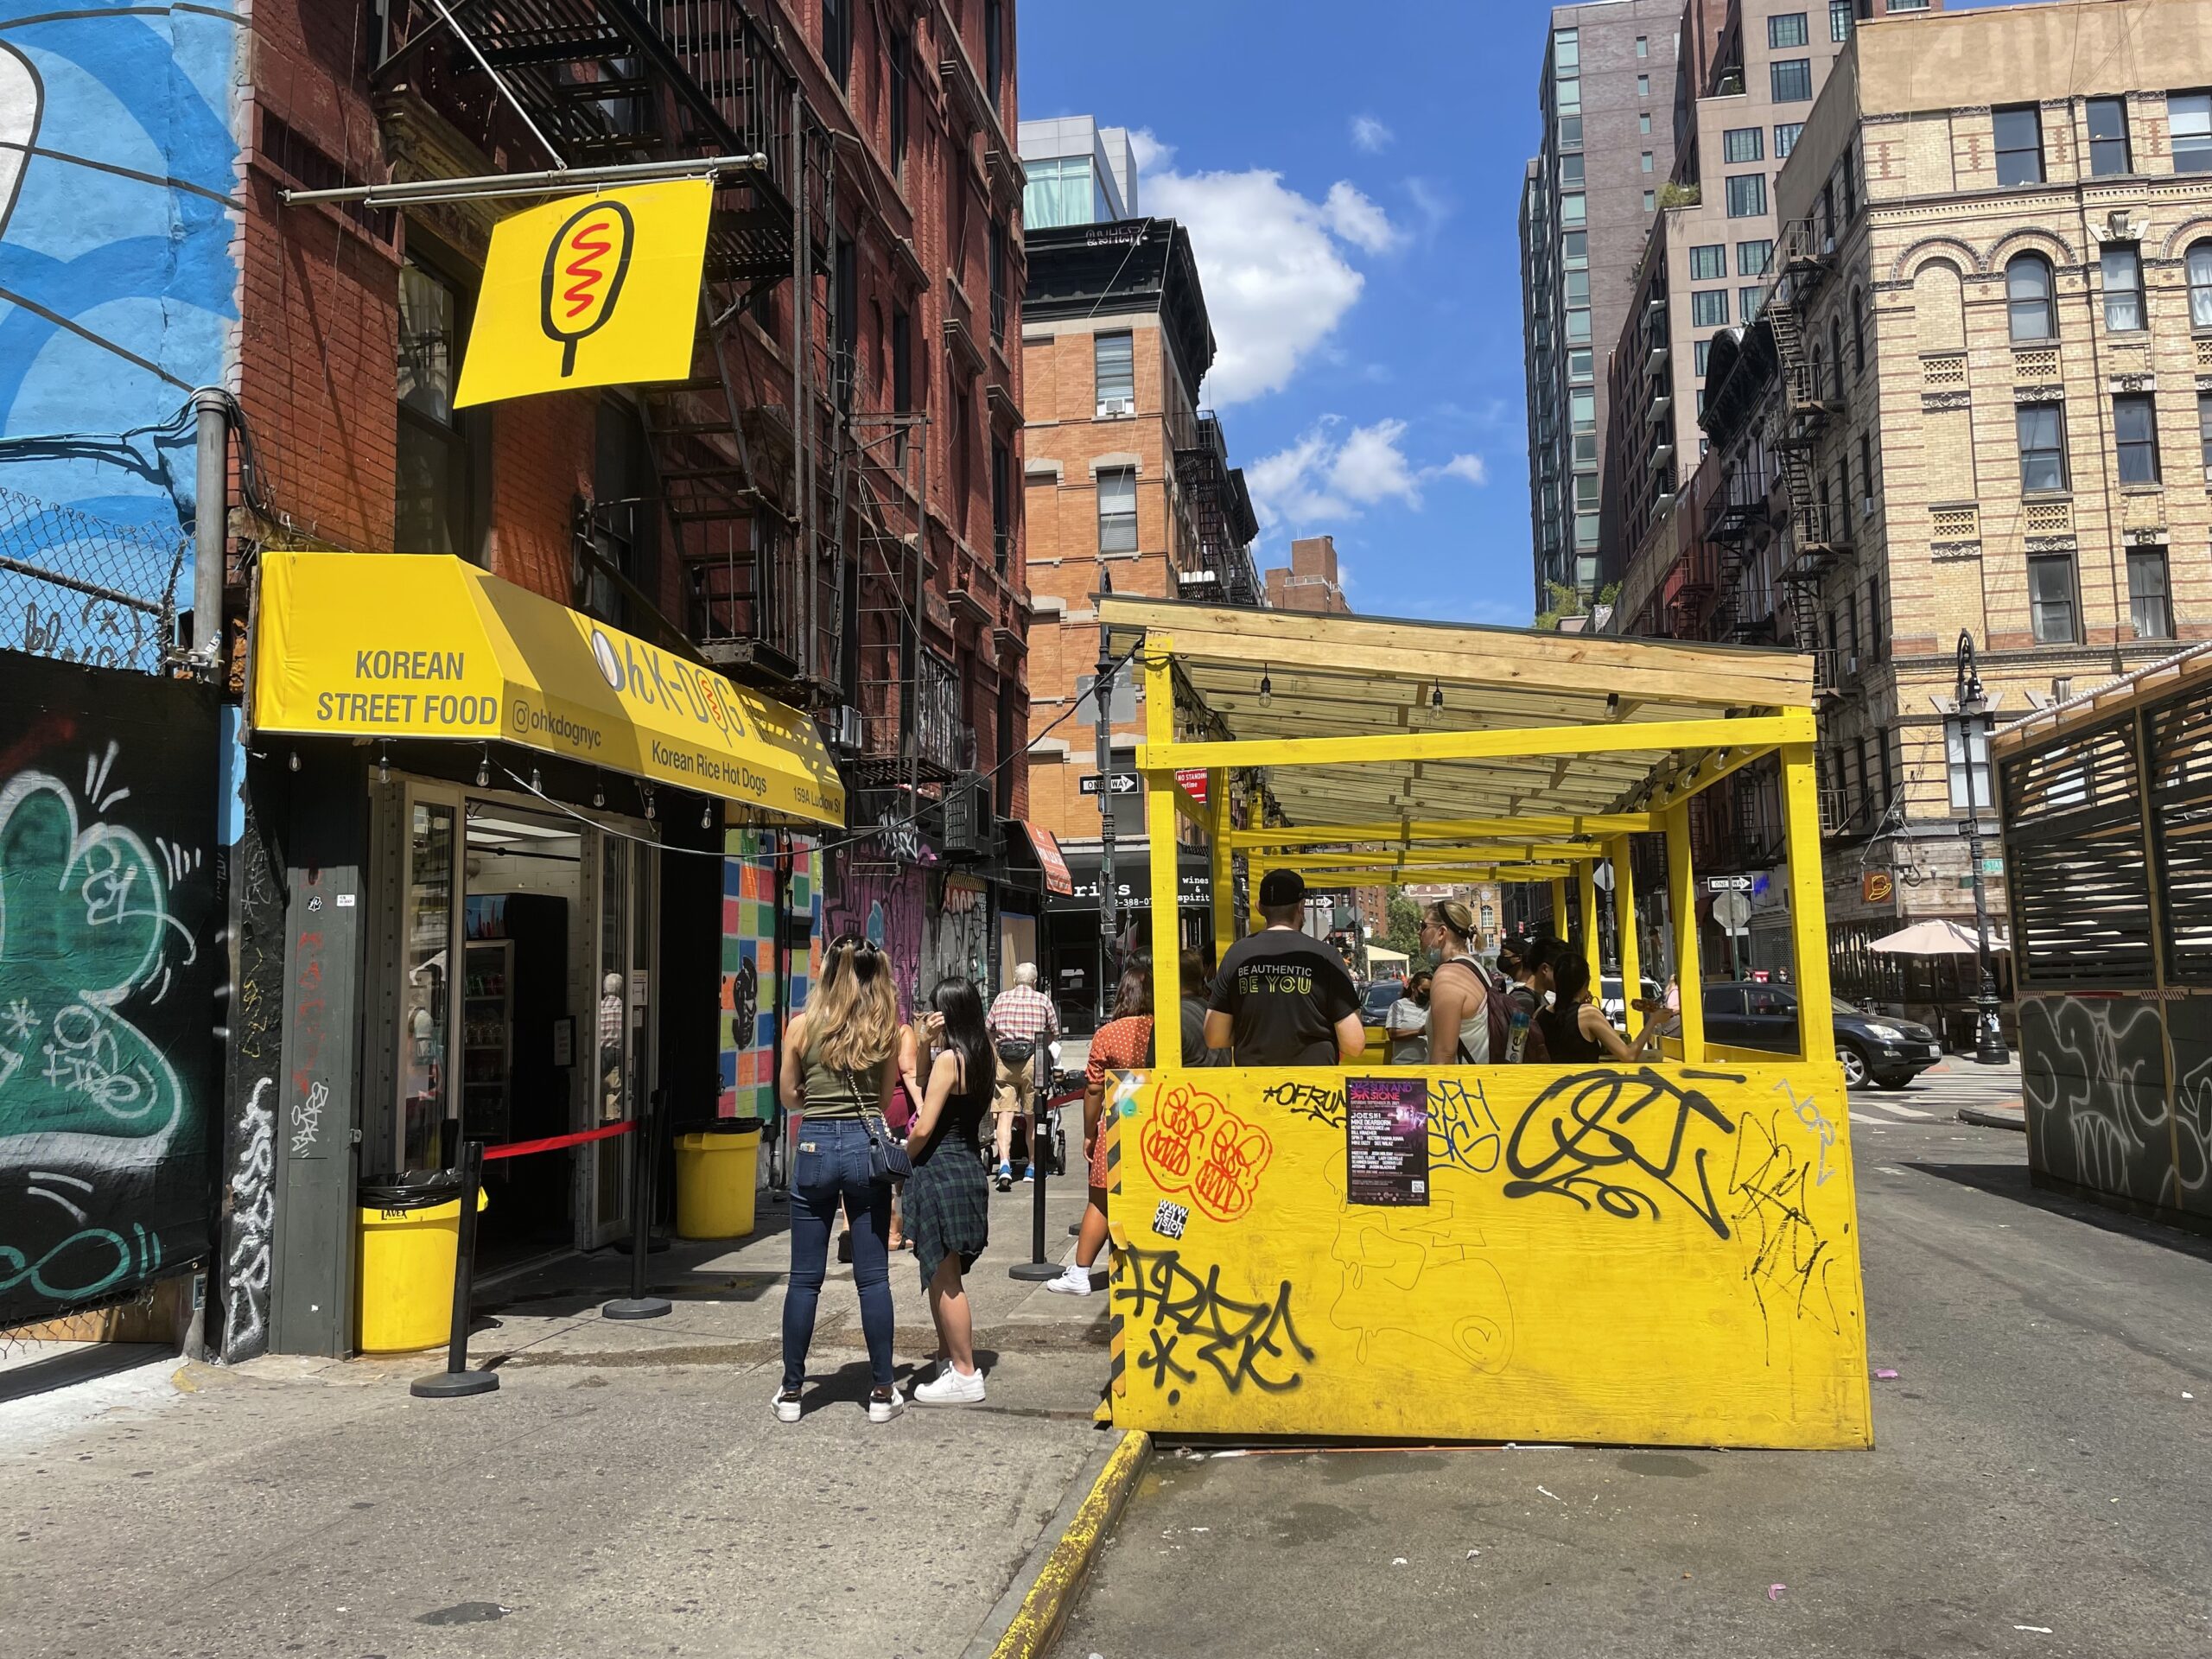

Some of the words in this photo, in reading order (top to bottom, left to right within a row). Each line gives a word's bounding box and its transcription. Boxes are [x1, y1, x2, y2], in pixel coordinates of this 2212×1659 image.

[355, 650, 465, 680] KOREAN
[316, 691, 418, 722] STREET
[423, 695, 498, 726] FOOD
[531, 709, 601, 749] ohkdognyc
[652, 740, 694, 772] Korean
[696, 753, 720, 779] Rice
[722, 760, 741, 786] Hot
[742, 767, 767, 797] Dogs
[1087, 781, 1104, 790] ONE
[1111, 779, 1128, 788] WAY
[1181, 781, 1198, 790] nytime
[793, 786, 810, 804] 159A
[810, 791, 834, 811] Ludlow
[834, 798, 841, 814] St
[1182, 875, 1209, 884] wines
[1177, 893, 1210, 903] spirit
[1238, 966, 1248, 977] BE
[1250, 964, 1313, 977] AUTHENTIC
[1238, 976, 1259, 995] BE
[1266, 976, 1312, 995] YOU
[1370, 1083, 1389, 1092] SUN
[1390, 1084, 1412, 1093] AND
[1370, 1092, 1401, 1101] STONE
[381, 1210, 408, 1221] LAVEX
[1156, 1206, 1183, 1225] CELL
[1154, 1214, 1184, 1238] VISION
